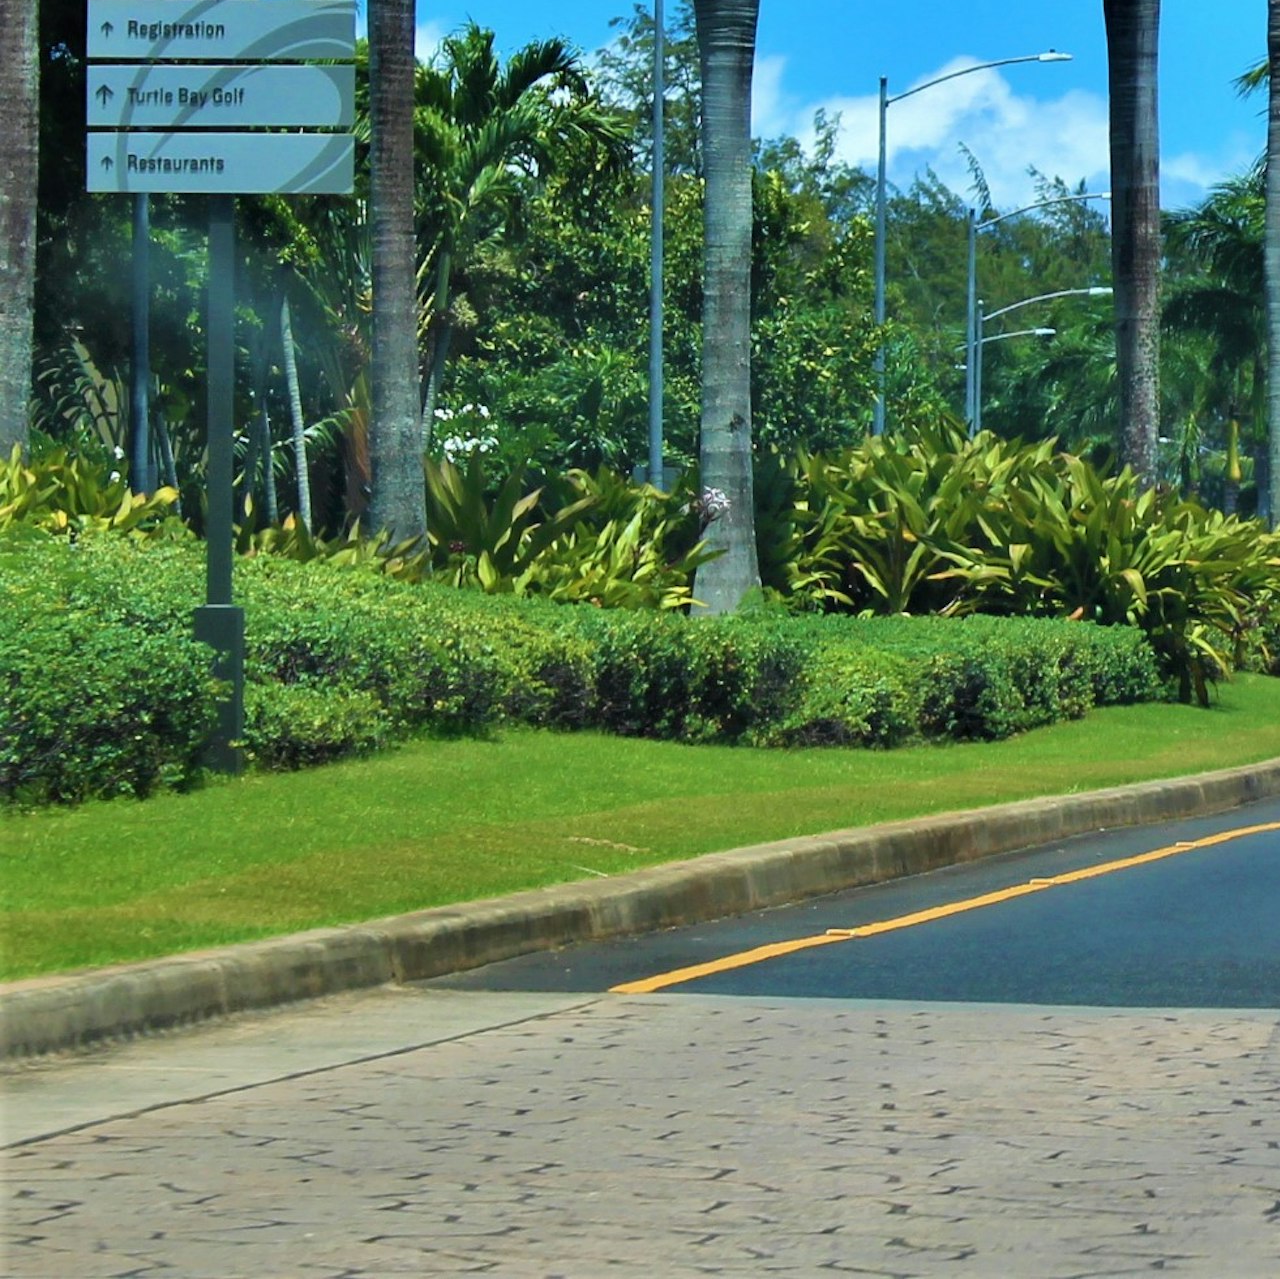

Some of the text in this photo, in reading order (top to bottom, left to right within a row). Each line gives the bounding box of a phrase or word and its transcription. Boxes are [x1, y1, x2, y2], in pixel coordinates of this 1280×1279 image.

[128, 20, 225, 41] Registration
[127, 87, 245, 109] Turtle Bay Golf
[127, 154, 225, 173] Restaurants
